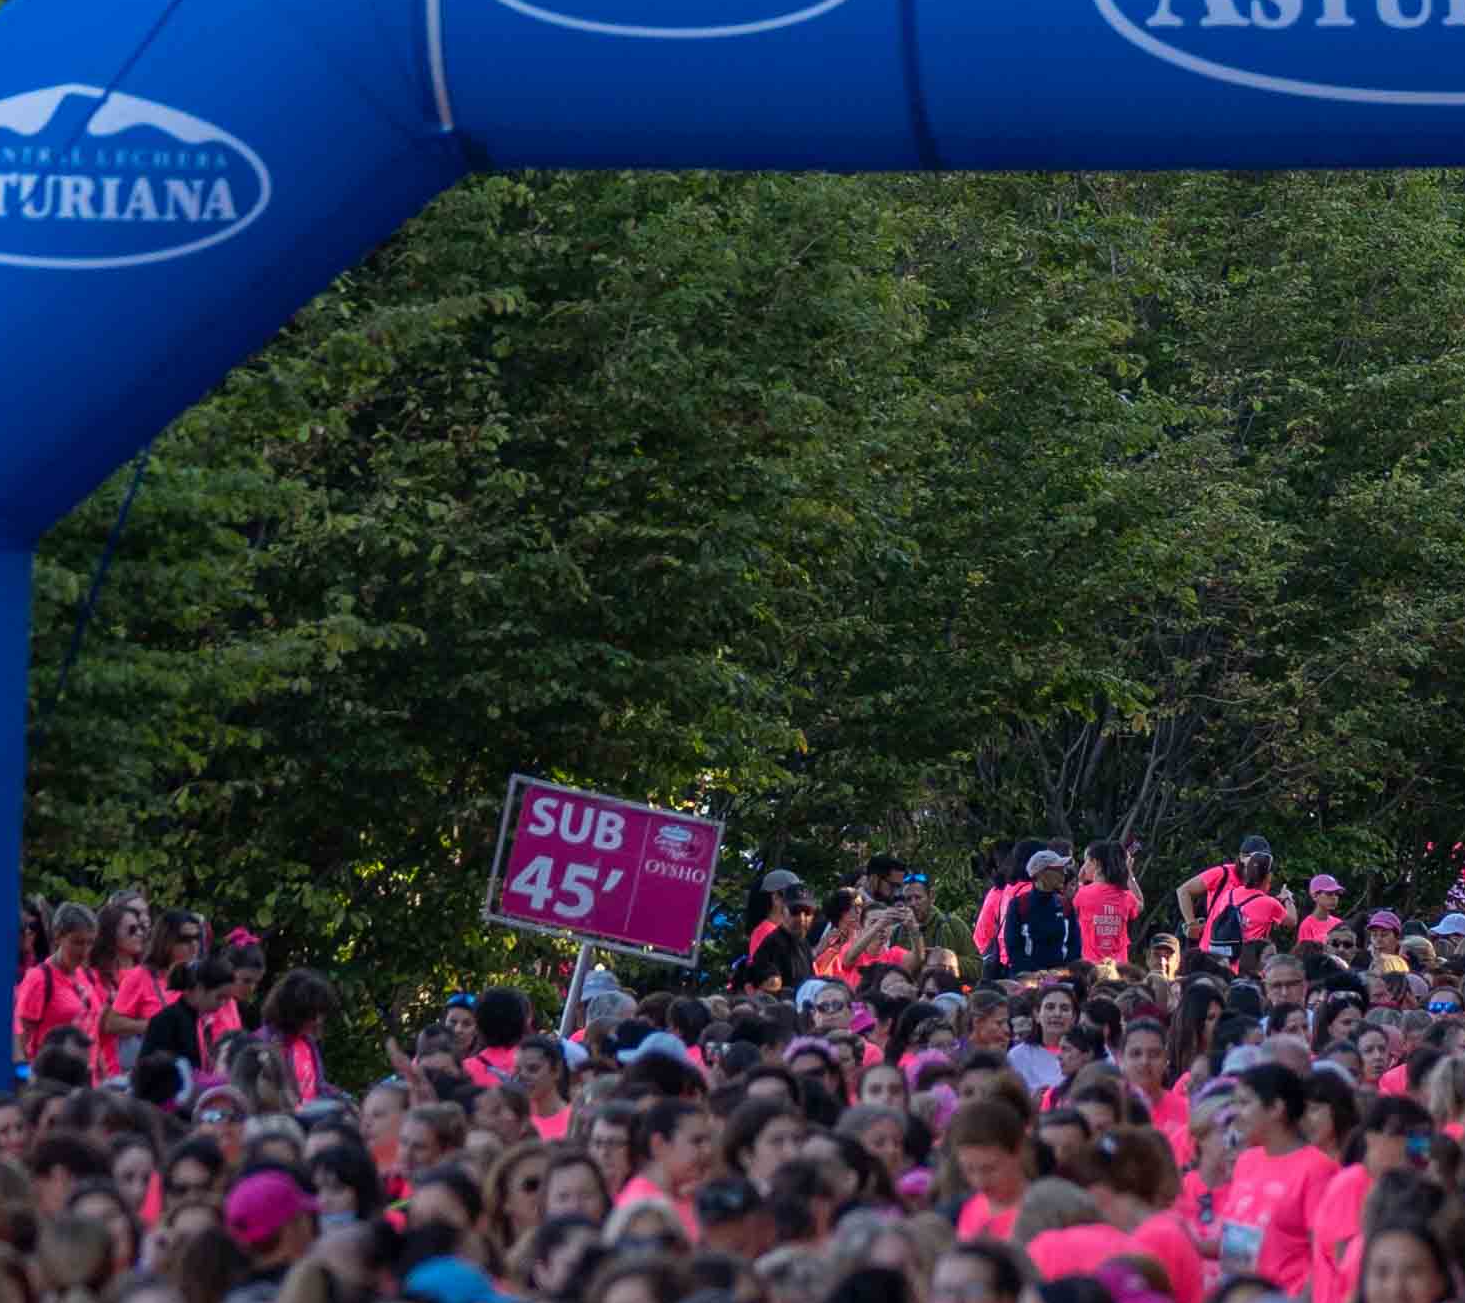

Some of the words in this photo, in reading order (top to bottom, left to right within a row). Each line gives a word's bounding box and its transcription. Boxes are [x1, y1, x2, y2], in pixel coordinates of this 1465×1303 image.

[97, 149, 230, 170] LECHERA
[528, 796, 625, 850] SUB
[644, 859, 706, 884] OYSHO
